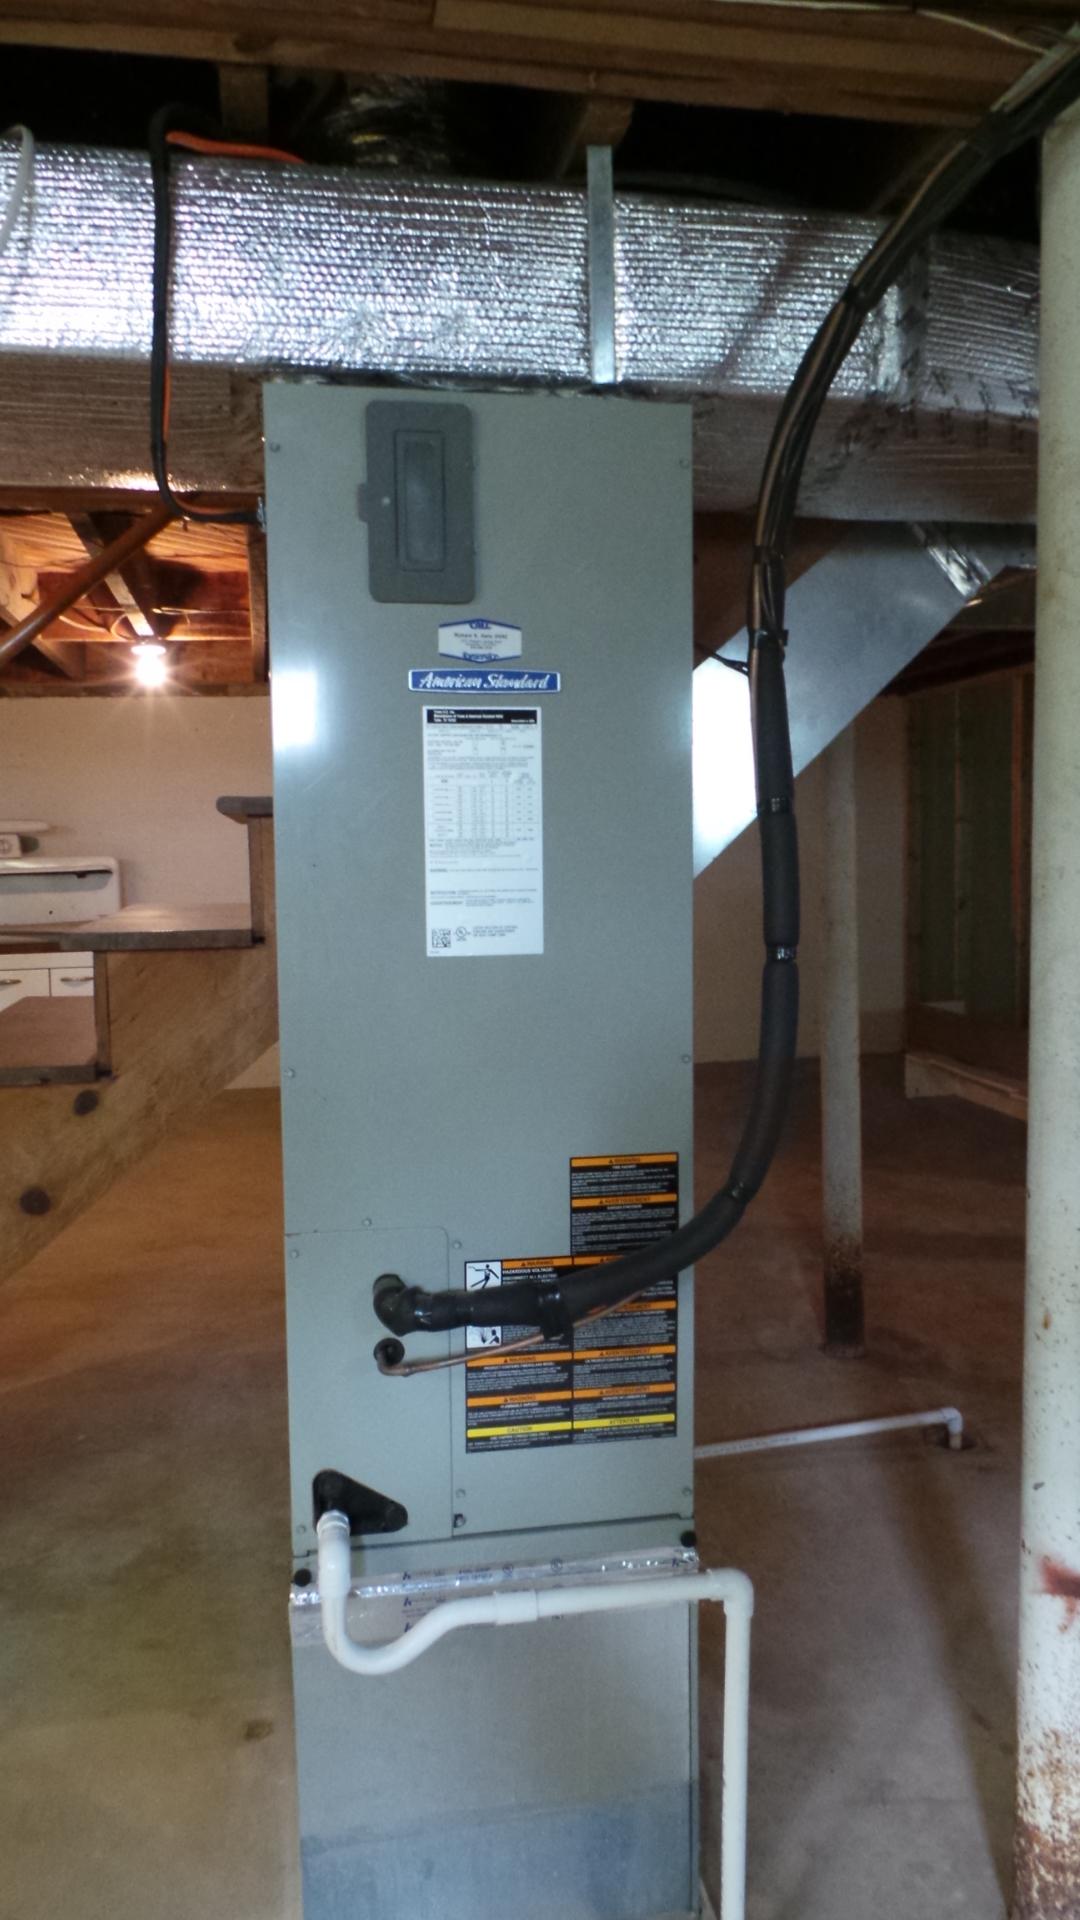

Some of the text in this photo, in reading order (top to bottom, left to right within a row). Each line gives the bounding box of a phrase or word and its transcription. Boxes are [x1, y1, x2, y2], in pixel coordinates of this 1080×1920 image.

[419, 672, 550, 689] American Standard
[609, 1417, 640, 1426] ATTENTION
